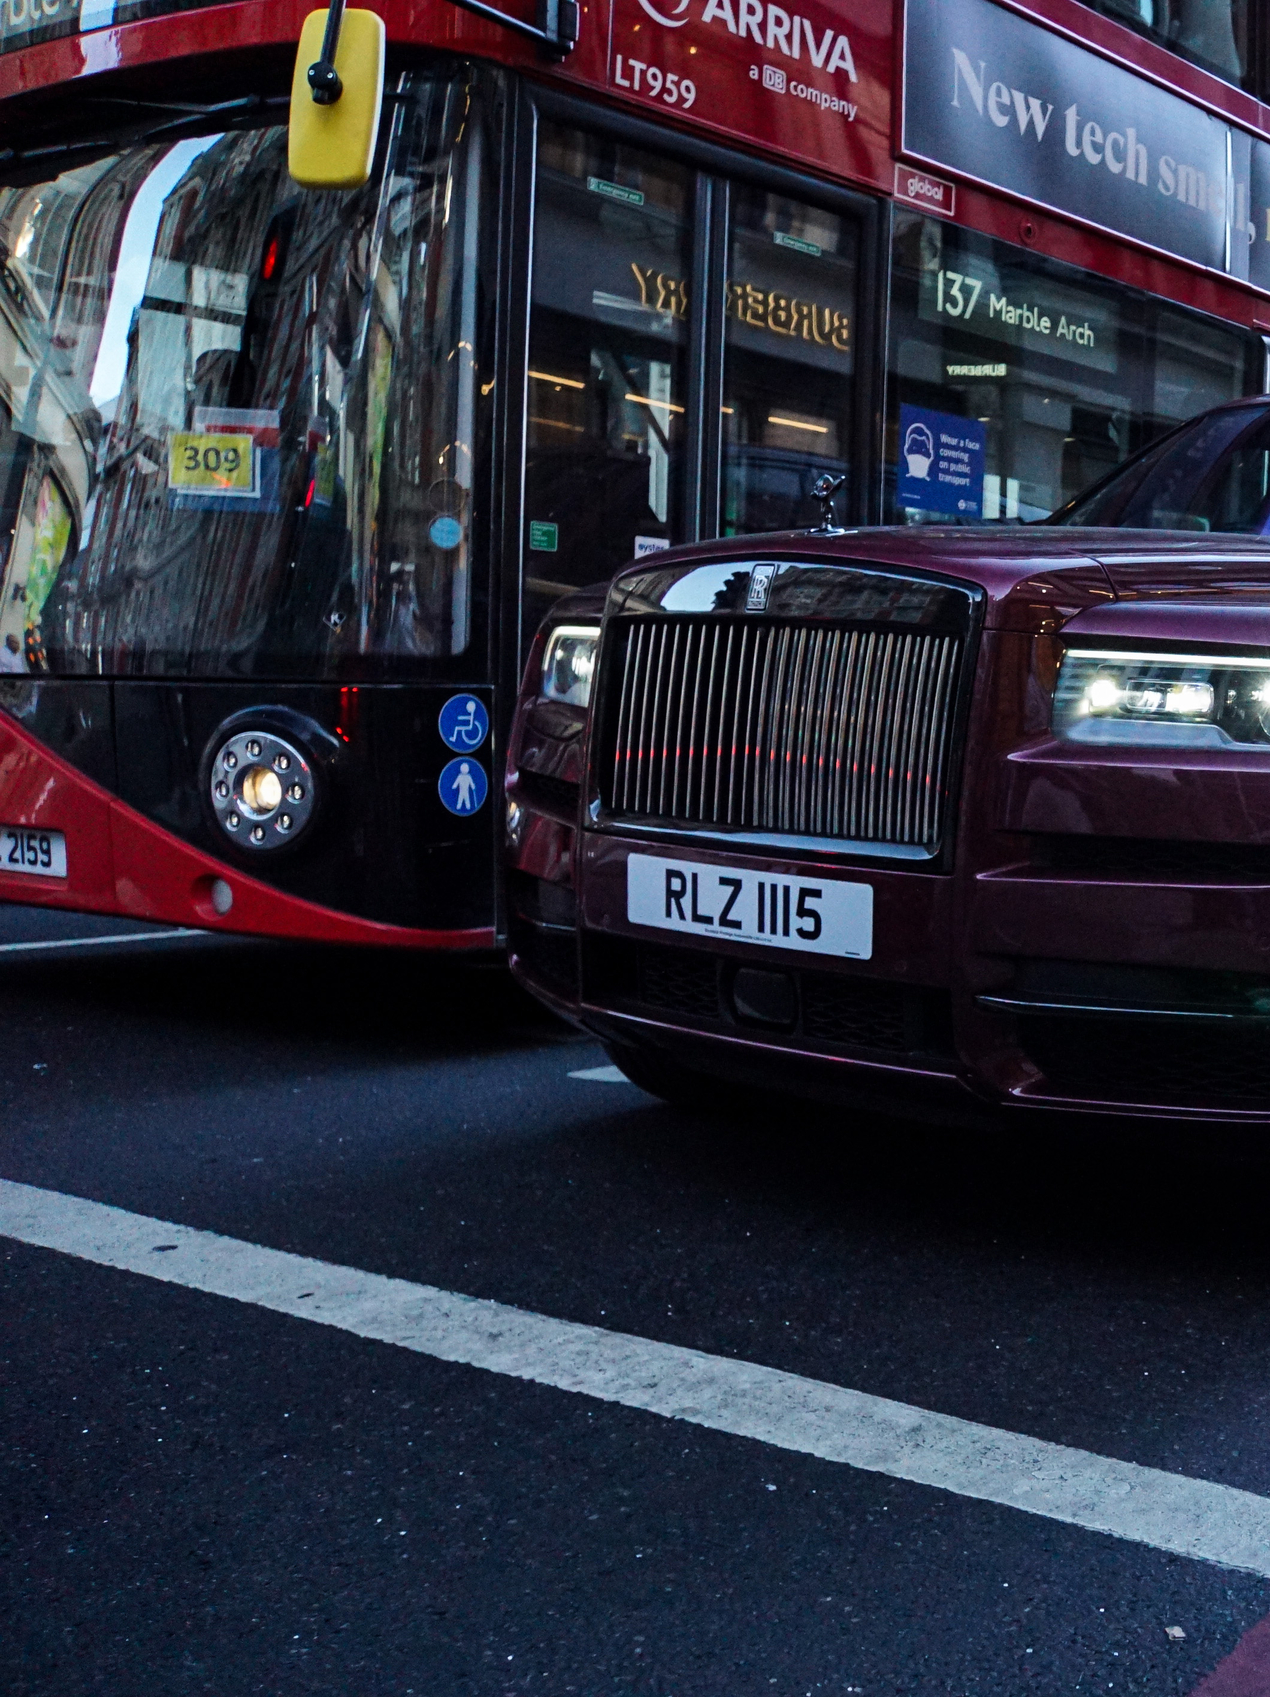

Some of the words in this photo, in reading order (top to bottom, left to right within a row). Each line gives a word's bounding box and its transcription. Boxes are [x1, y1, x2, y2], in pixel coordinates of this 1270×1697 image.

[701, 0, 858, 84] ARRIVA
[615, 54, 697, 109] LT959
[749, 64, 759, 81] a
[790, 81, 858, 121] company
[950, 47, 1054, 143] New
[1064, 103, 1148, 187] tech
[907, 176, 944, 202] global
[937, 270, 983, 320] 137
[989, 293, 1051, 335] Marble
[1056, 316, 1095, 347] Arch
[184, 445, 242, 473] 309
[939, 461, 949, 469] on
[949, 462, 971, 474] public
[940, 448, 969, 462] covering
[938, 473, 970, 487] transport
[7, 832, 52, 868] 2159
[665, 868, 742, 930] RLZ
[757, 881, 823, 941] 1115
